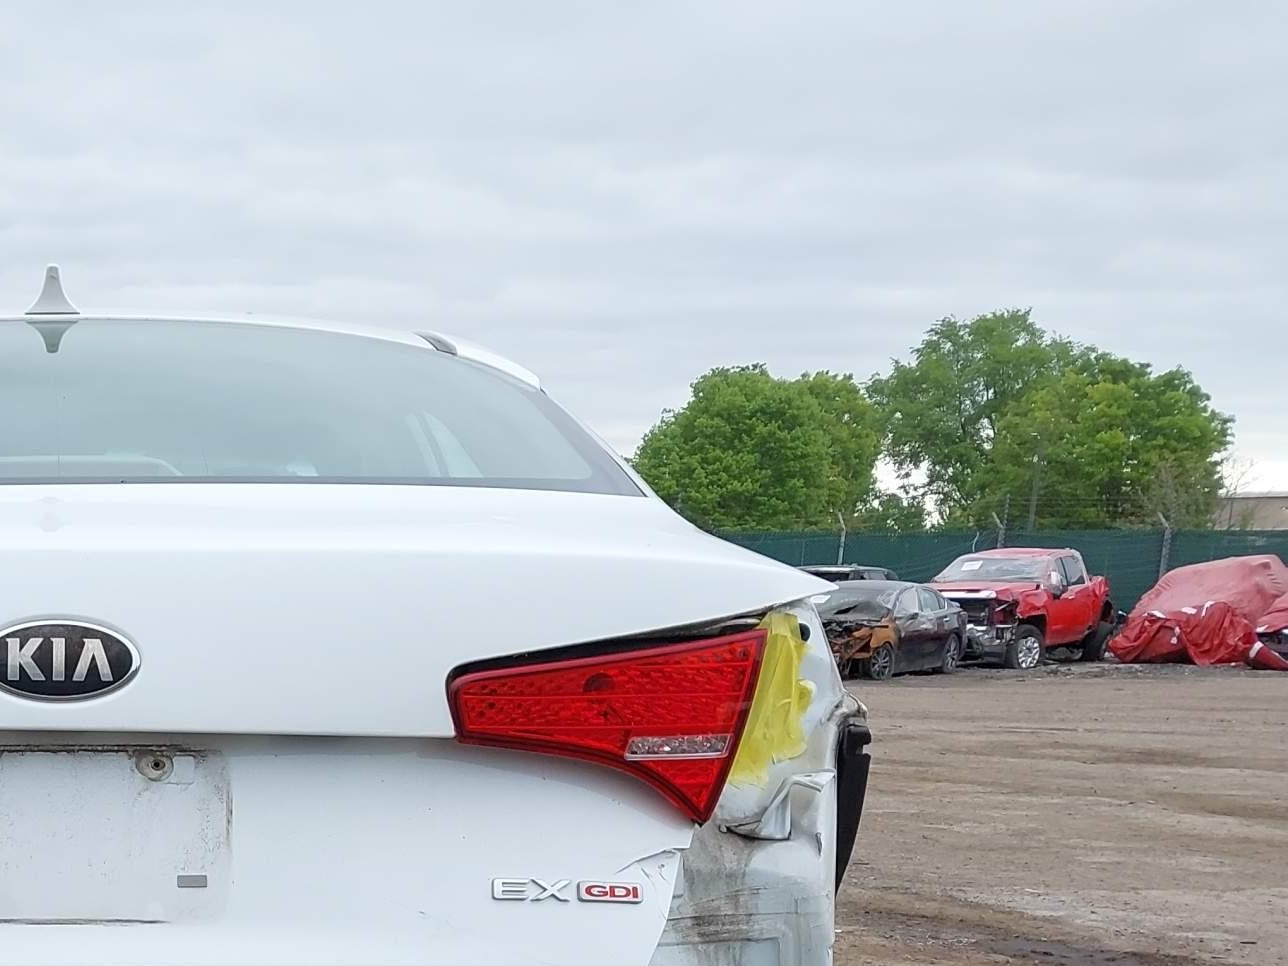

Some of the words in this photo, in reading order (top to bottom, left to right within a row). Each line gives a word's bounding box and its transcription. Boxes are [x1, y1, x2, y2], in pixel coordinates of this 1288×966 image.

[5, 637, 114, 682] KIA
[492, 877, 572, 902] EX
[584, 884, 639, 899] GDI
